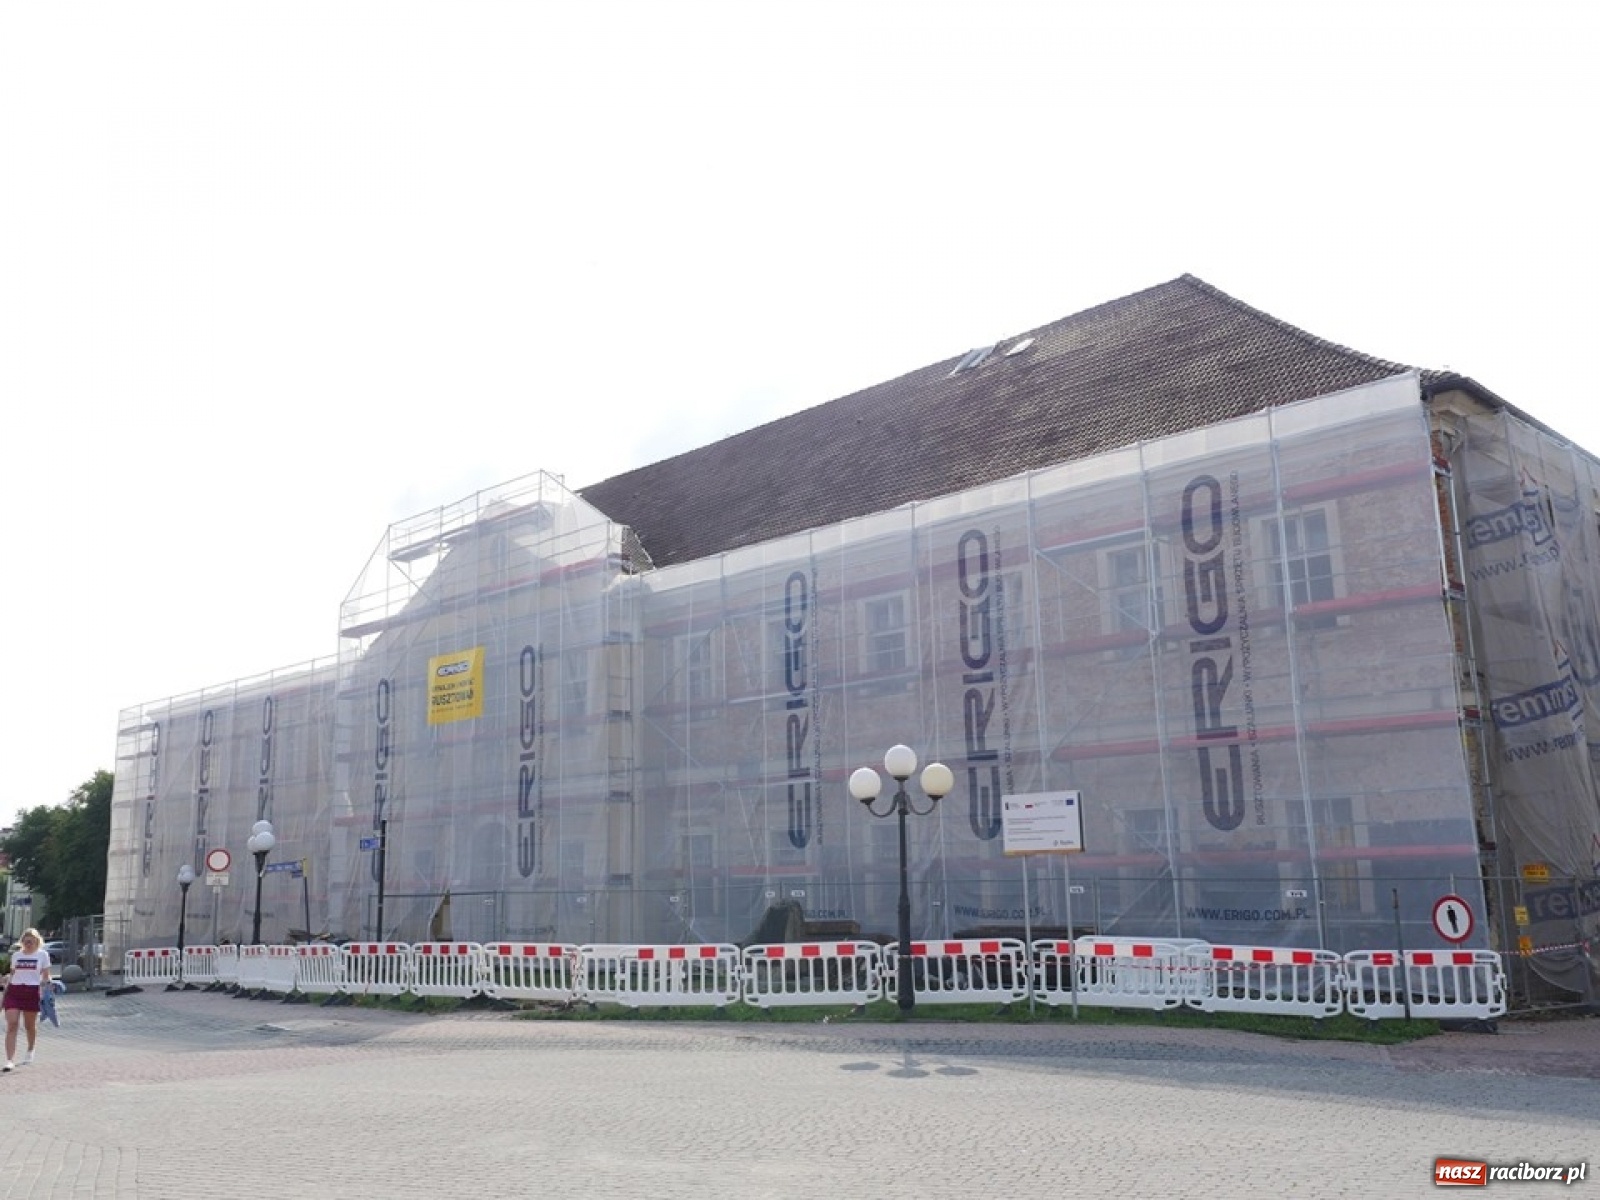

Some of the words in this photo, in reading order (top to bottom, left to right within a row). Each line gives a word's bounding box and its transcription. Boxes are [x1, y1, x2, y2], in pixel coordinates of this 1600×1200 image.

[517, 645, 536, 878] ERIGO
[785, 571, 811, 849] ERIGO
[958, 529, 1002, 841] ERIGO
[1182, 474, 1245, 831] ERIGO
[1185, 906, 1311, 922] WWW.ERIGO.COM.PL
